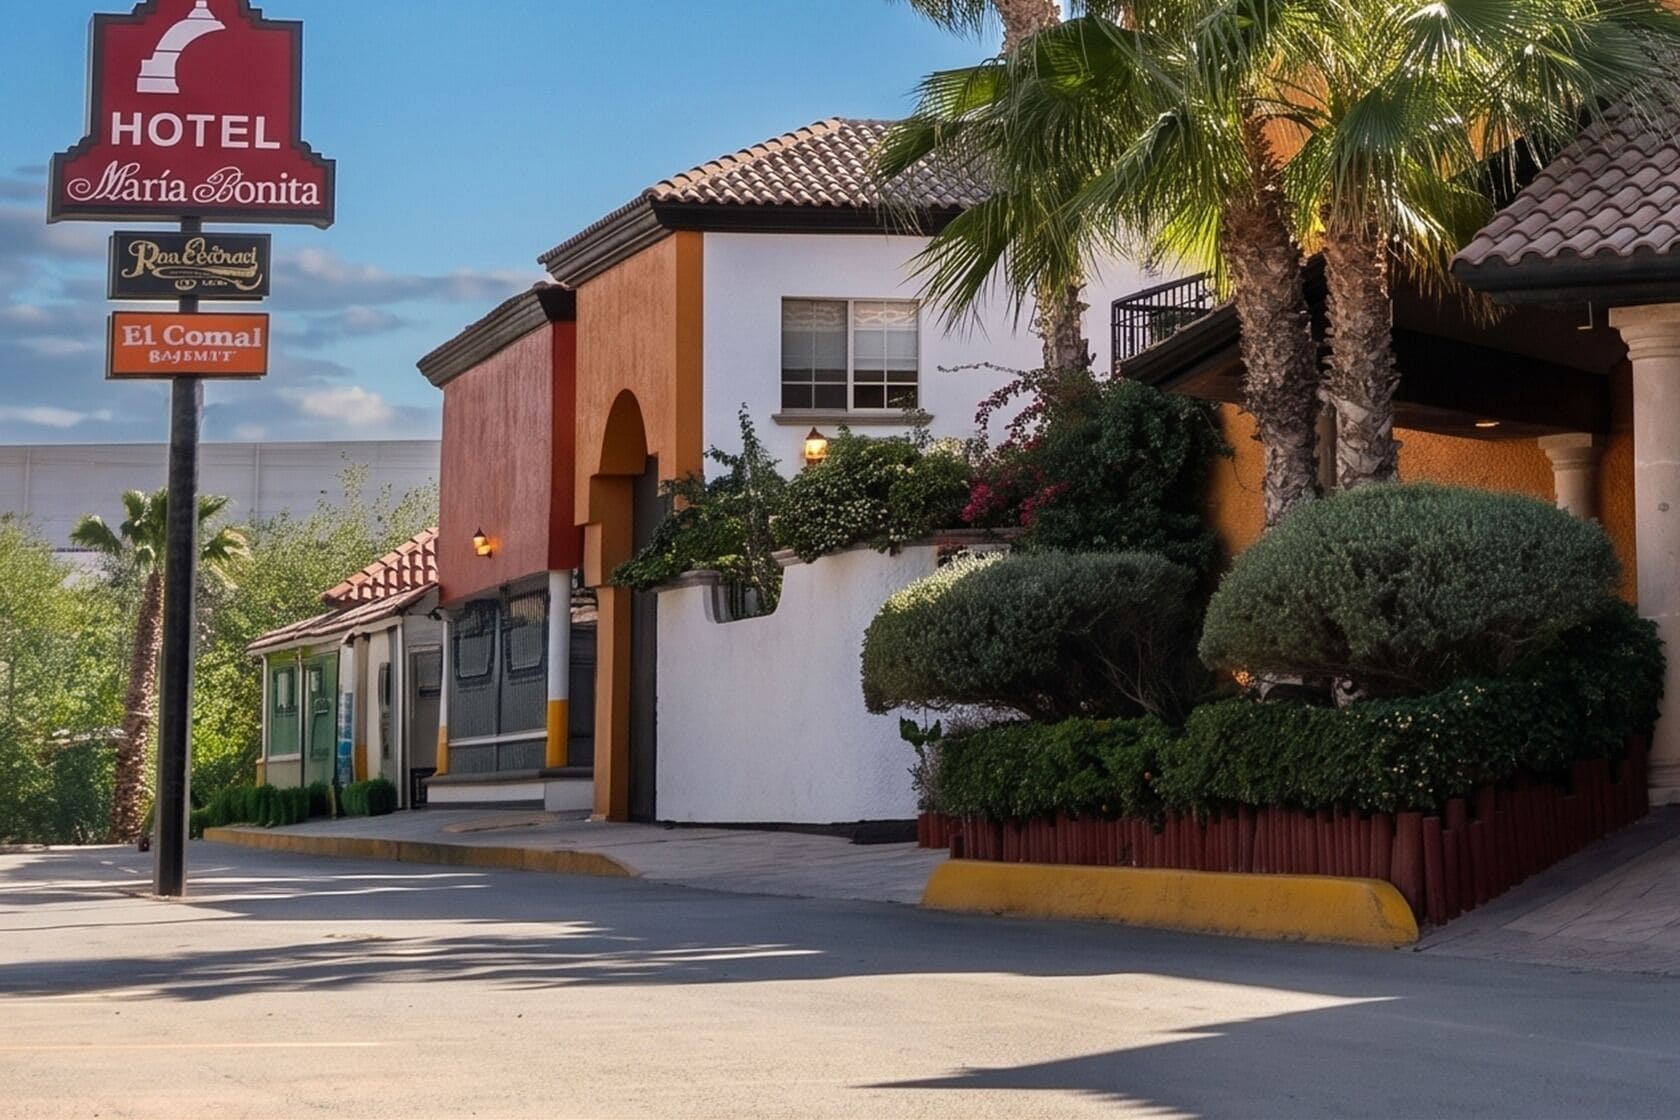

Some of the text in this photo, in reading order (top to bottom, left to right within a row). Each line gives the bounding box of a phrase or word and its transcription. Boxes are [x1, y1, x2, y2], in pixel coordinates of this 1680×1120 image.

[110, 111, 281, 149] HOTEL
[66, 159, 321, 205] María Bonita
[121, 324, 262, 348] El Comal
